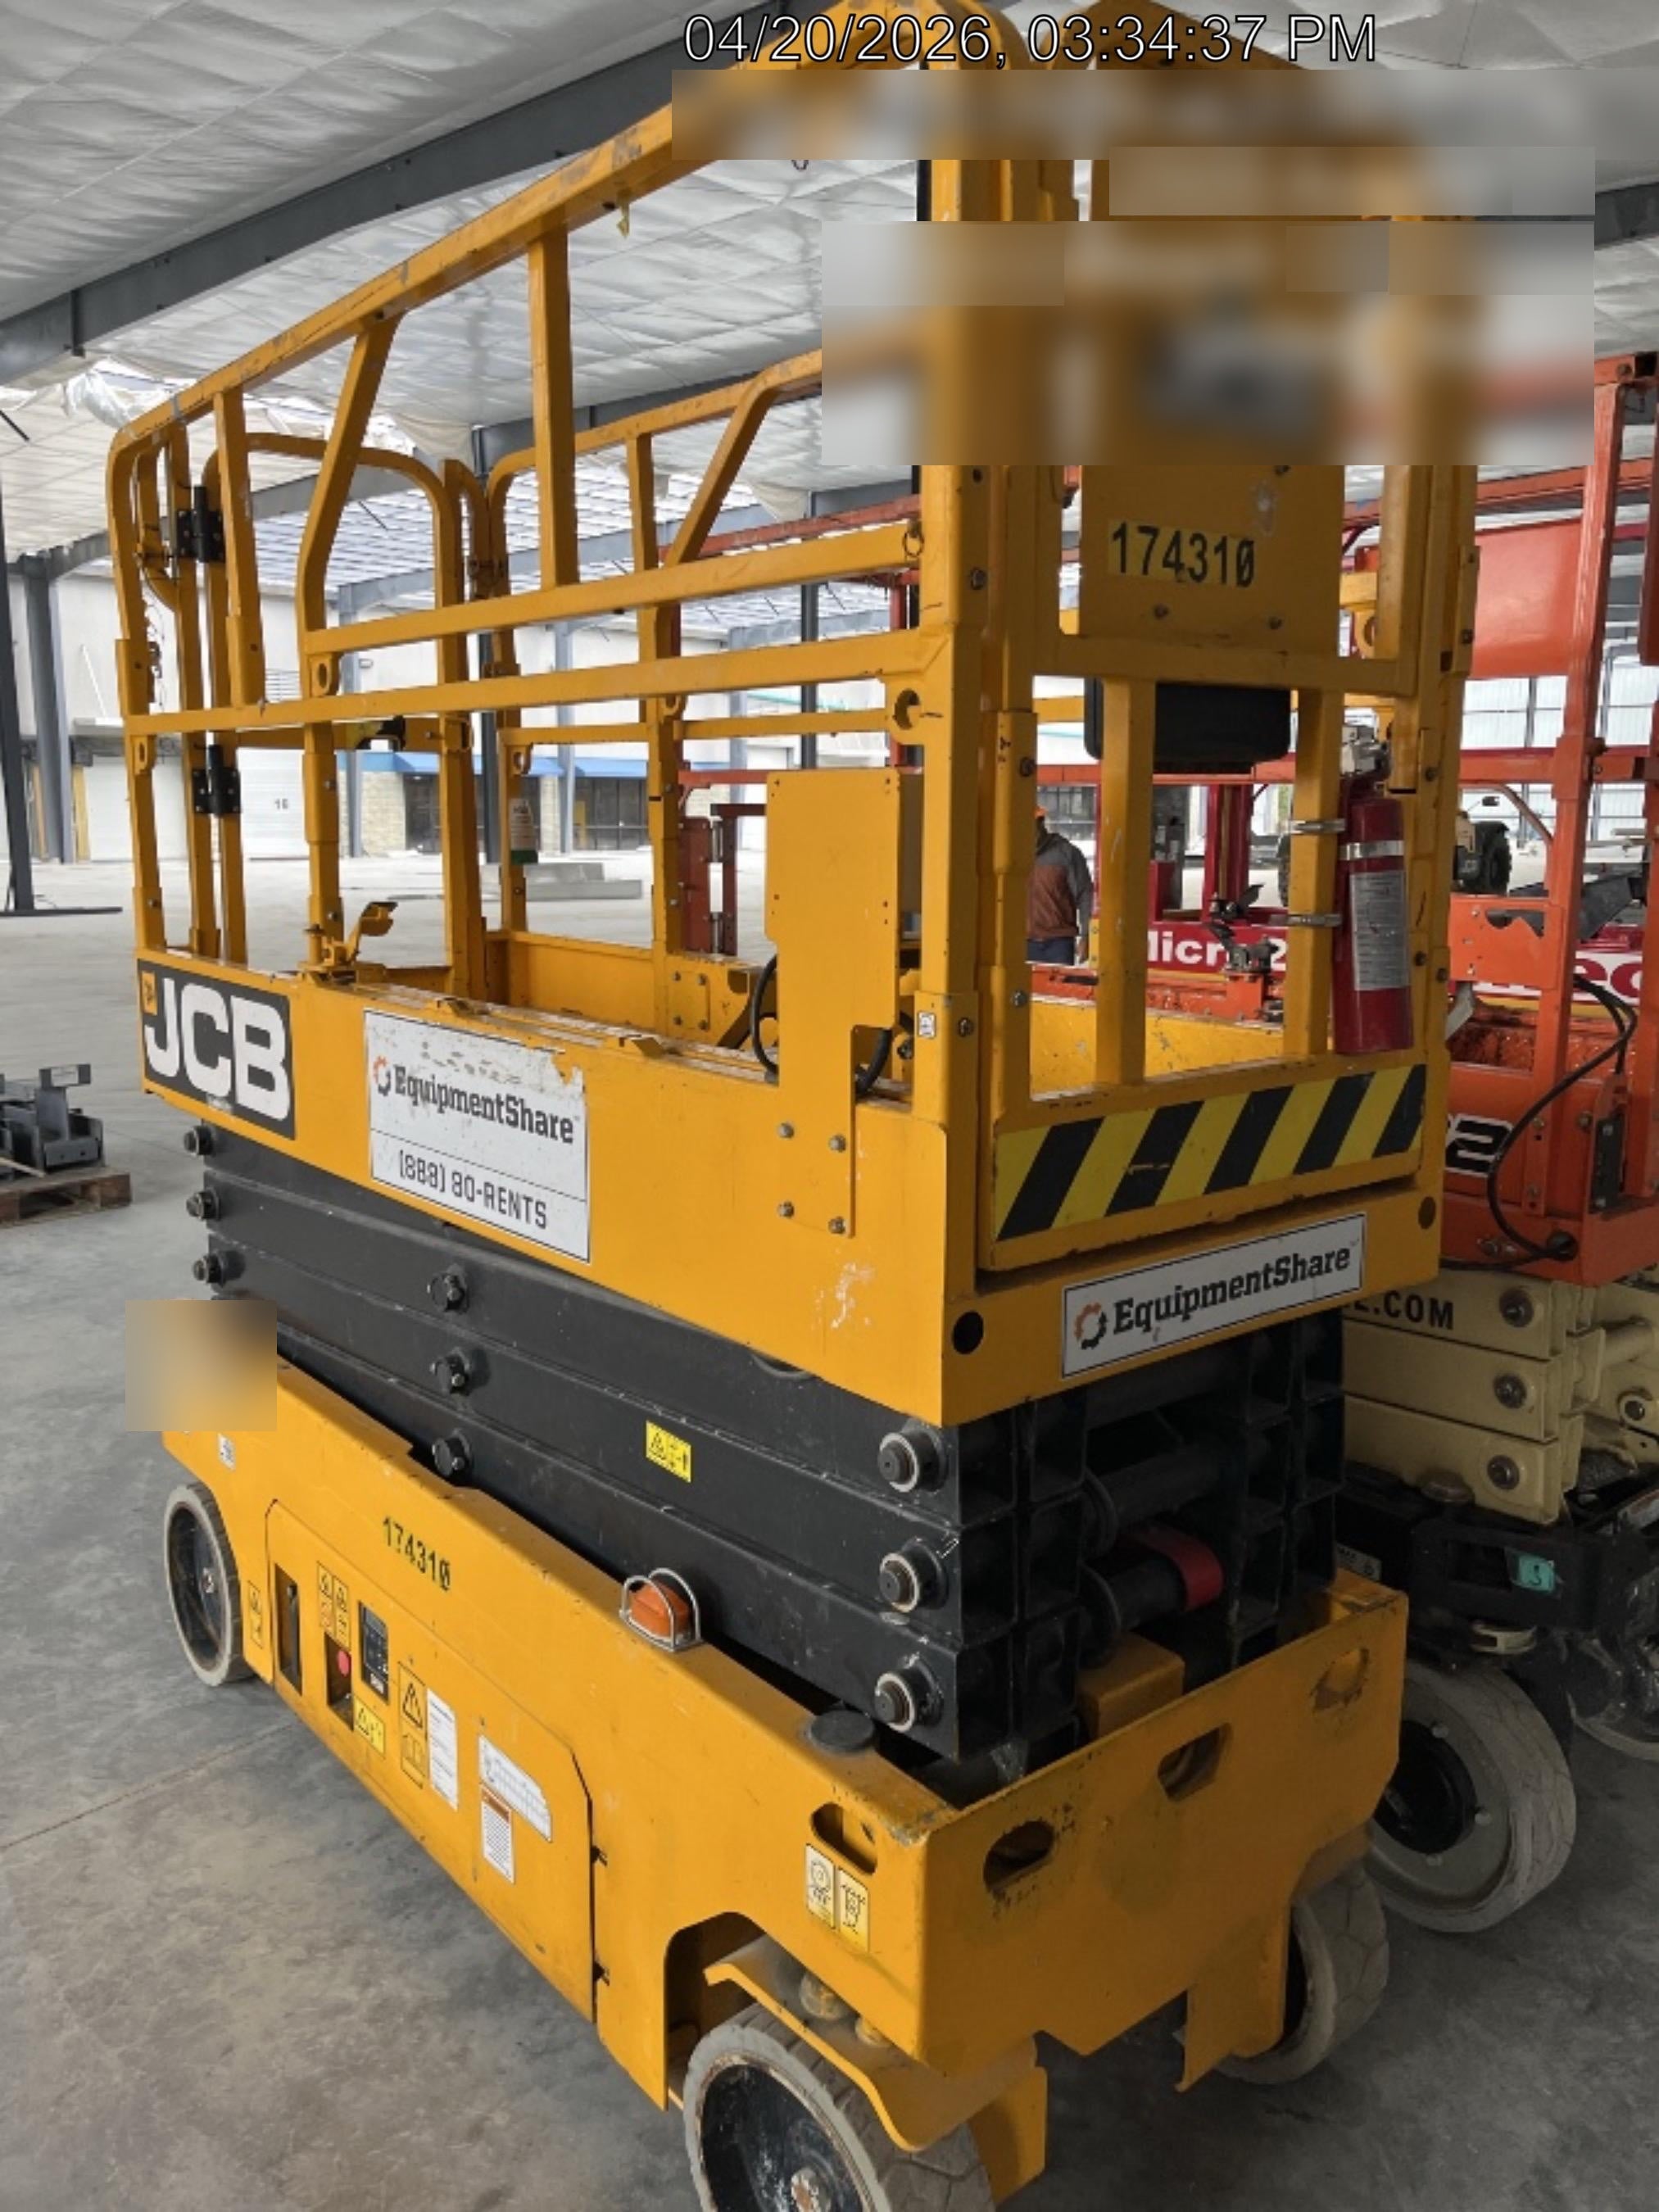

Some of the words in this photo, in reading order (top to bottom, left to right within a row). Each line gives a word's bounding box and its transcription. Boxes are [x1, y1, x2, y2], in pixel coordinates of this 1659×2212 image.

[1113, 521, 1255, 587] 174310
[144, 977, 291, 1122] JCB
[393, 1064, 573, 1144] EquipmentShare
[399, 1149, 446, 1193] (888)
[451, 1177, 547, 1230] 80-RENTS
[1113, 1246, 1351, 1335] EquipmentShare
[1354, 1290, 1453, 1330] .COM
[383, 1516, 451, 1592] 174310
